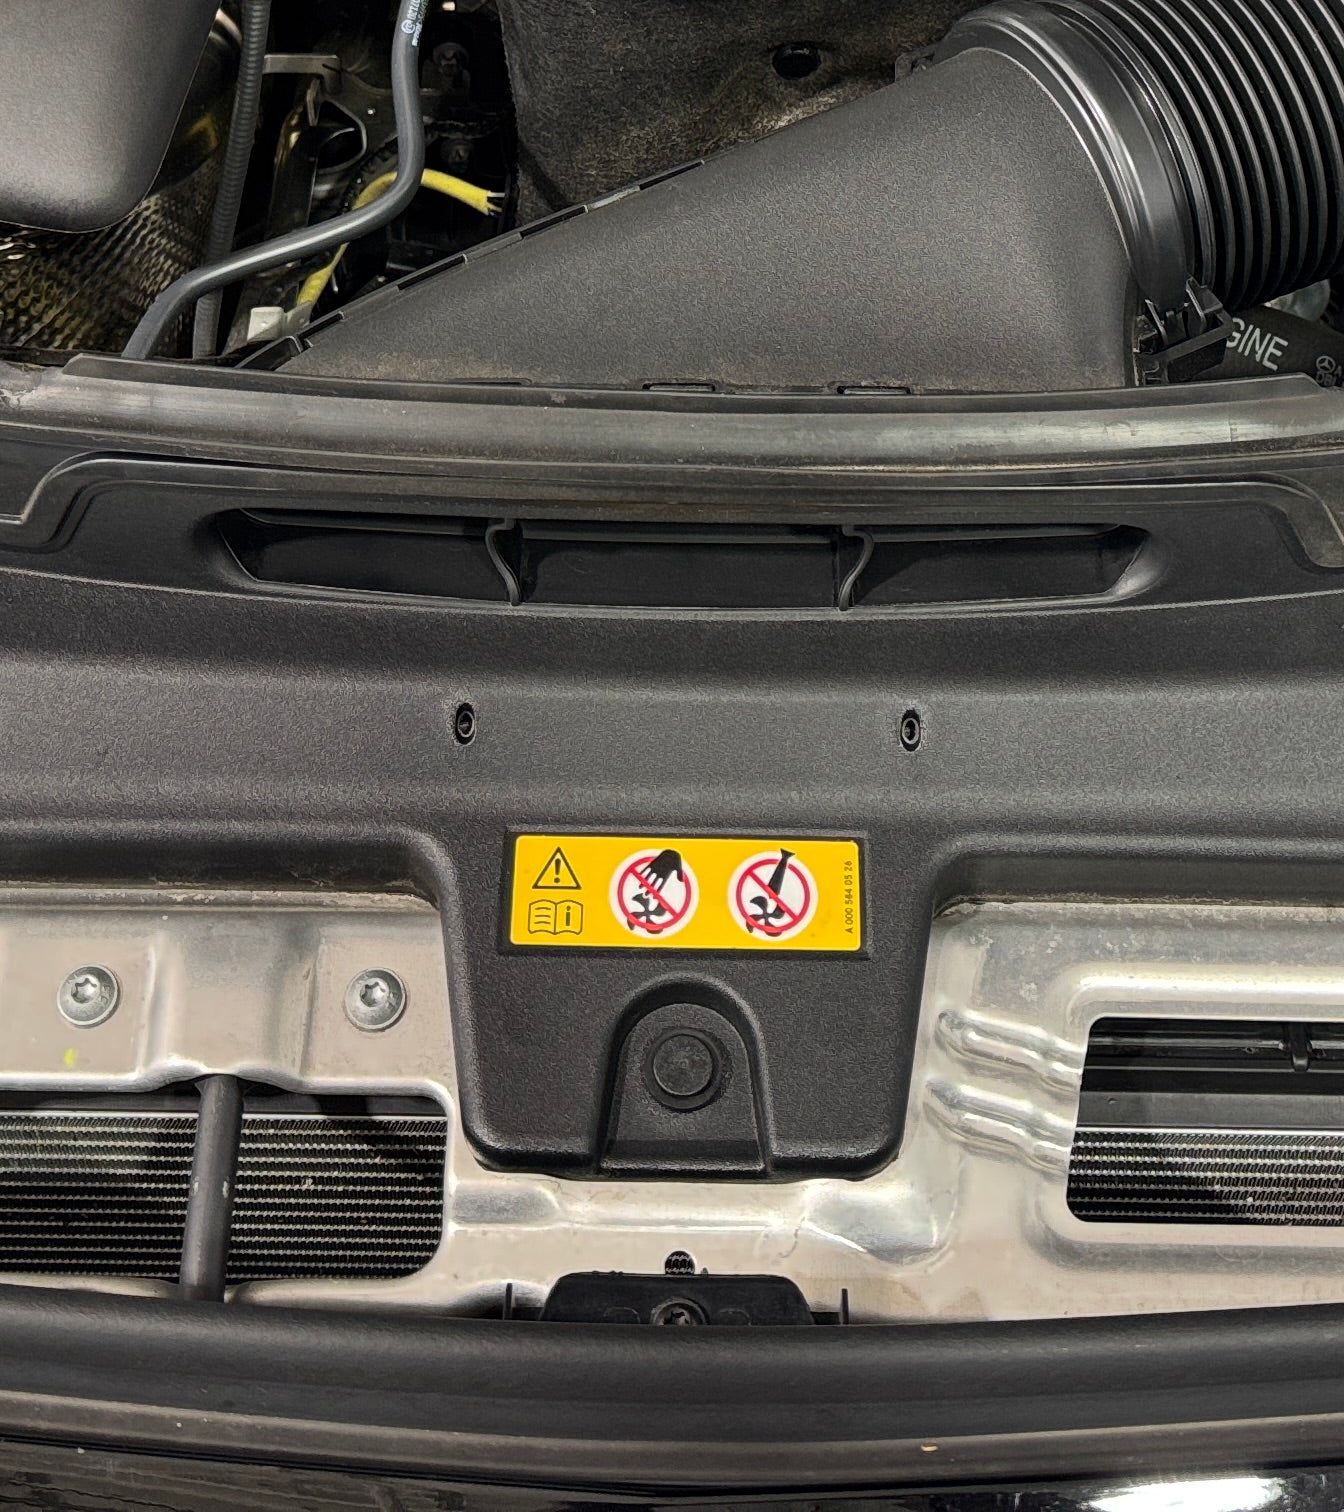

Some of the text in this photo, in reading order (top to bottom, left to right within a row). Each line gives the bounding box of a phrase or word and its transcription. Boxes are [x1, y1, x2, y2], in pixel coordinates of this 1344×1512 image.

[1225, 316, 1290, 372] GINE
[843, 860, 854, 935] A 000 584 05 26
